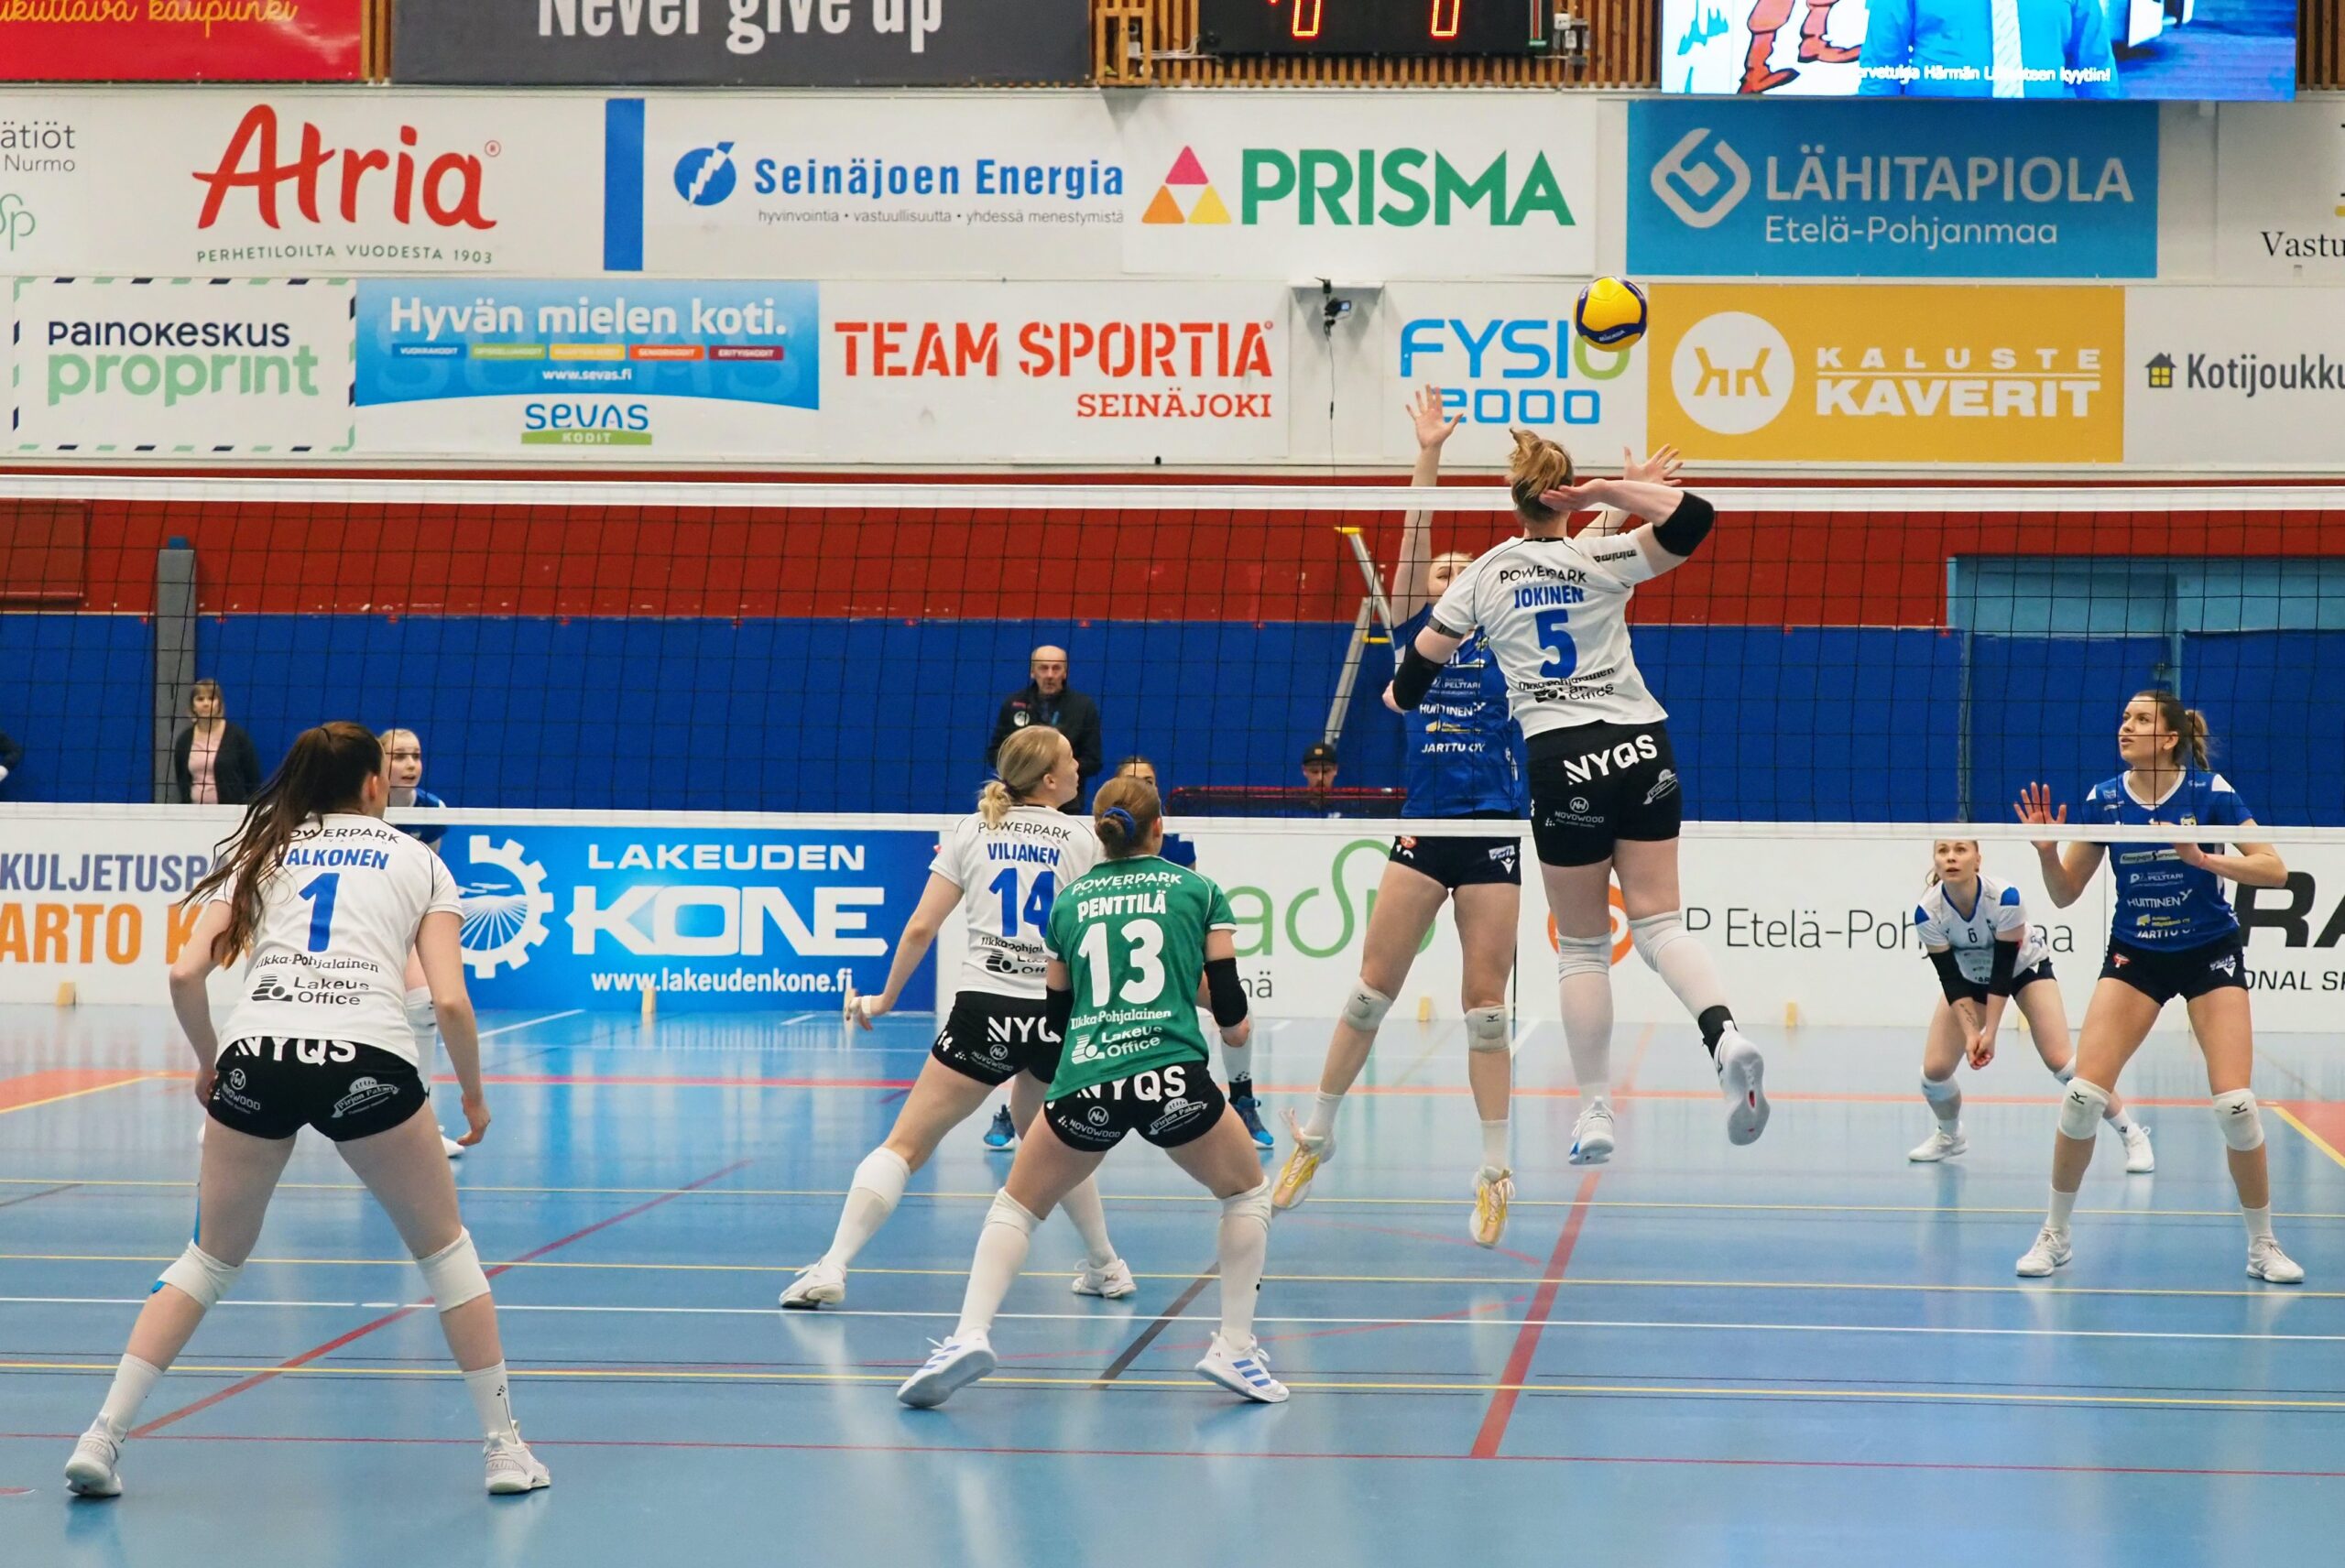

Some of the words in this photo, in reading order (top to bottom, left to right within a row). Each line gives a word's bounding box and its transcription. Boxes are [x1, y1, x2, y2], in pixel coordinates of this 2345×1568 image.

[873, 0, 942, 52] up
[0, 121, 76, 149] ätiöt
[5, 154, 76, 172] Nurmo
[191, 103, 497, 230] Atria
[1767, 144, 2134, 203] LÄHITAPIOLA
[754, 158, 959, 199] Seinäjoen
[976, 158, 1124, 199] Energia
[1242, 147, 1576, 227] PRISMA
[758, 209, 840, 225] hyvinvointia
[854, 210, 952, 224] vastuullisuutta
[966, 209, 1024, 225] yhdessä
[1029, 209, 1124, 225] menestymistä
[1767, 214, 2058, 249] Etelä-Pohjanmaa
[197, 244, 335, 264] PERHETILOILTA
[346, 244, 443, 262] VUODESTA
[453, 248, 494, 264] 1903
[391, 297, 523, 342] Hyvän
[539, 297, 677, 334] mielen
[693, 298, 787, 336] koti.
[834, 321, 998, 376] TEAM
[1019, 321, 1272, 377] SPORTIA
[1818, 348, 2101, 370] KALUSTE
[48, 344, 319, 407] proprint
[542, 368, 632, 382] www.sevas.fi
[1077, 387, 1272, 418] SEINÄJOKI
[1816, 379, 2102, 418] KAVERIT
[562, 433, 612, 444] KODIT
[1514, 585, 1584, 609] JOKINEN
[1534, 609, 1577, 679] 5
[290, 828, 400, 844] OWERPARK
[286, 848, 389, 870] ALKONEN
[588, 844, 865, 871] LAKEUDEN
[987, 842, 1060, 866] VILJANEN
[1071, 872, 1183, 896] POWERPARK
[299, 873, 341, 953] 1
[1077, 889, 1167, 923] PENTTILÄ
[565, 886, 889, 957] KONE
[1968, 927, 1978, 943] 6
[1078, 919, 1165, 1007] 13
[294, 976, 370, 991] Lakeus
[592, 968, 853, 994] www.lakeudenkone.fi
[298, 991, 361, 1006] Office
[1107, 1037, 1161, 1057] Office
